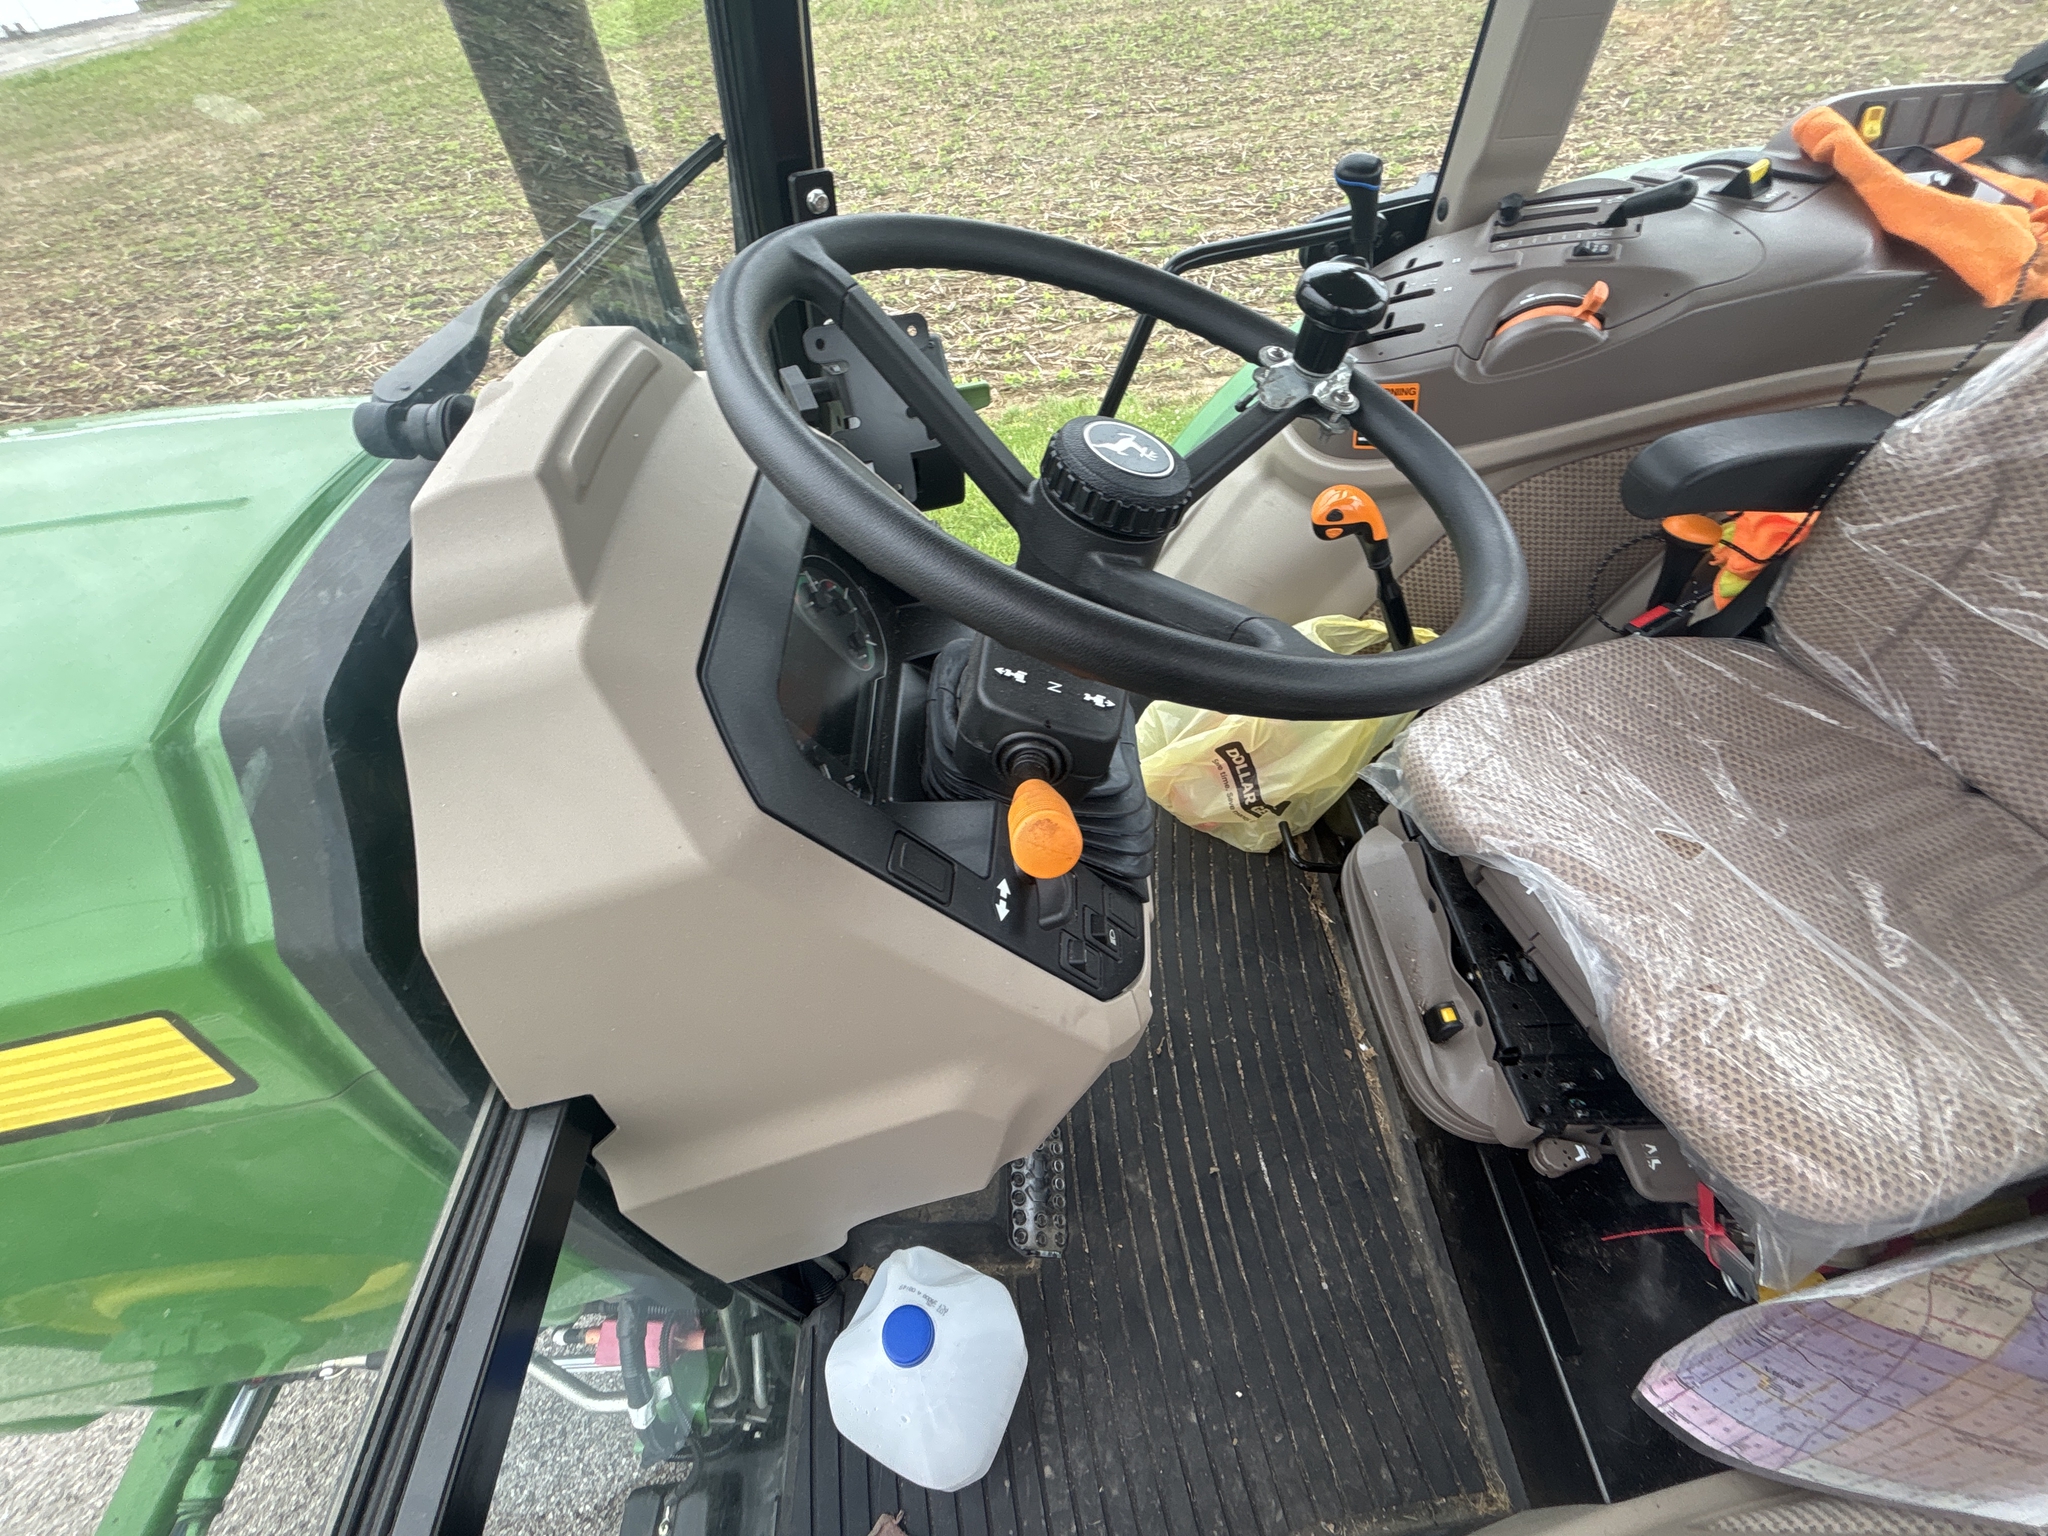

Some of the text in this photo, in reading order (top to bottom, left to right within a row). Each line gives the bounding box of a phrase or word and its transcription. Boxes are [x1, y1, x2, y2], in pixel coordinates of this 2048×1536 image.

[1385, 387, 1417, 396] NING
[1046, 681, 1063, 693] N
[1225, 747, 1257, 806] DOLLAR
[1226, 792, 1236, 811] Save
